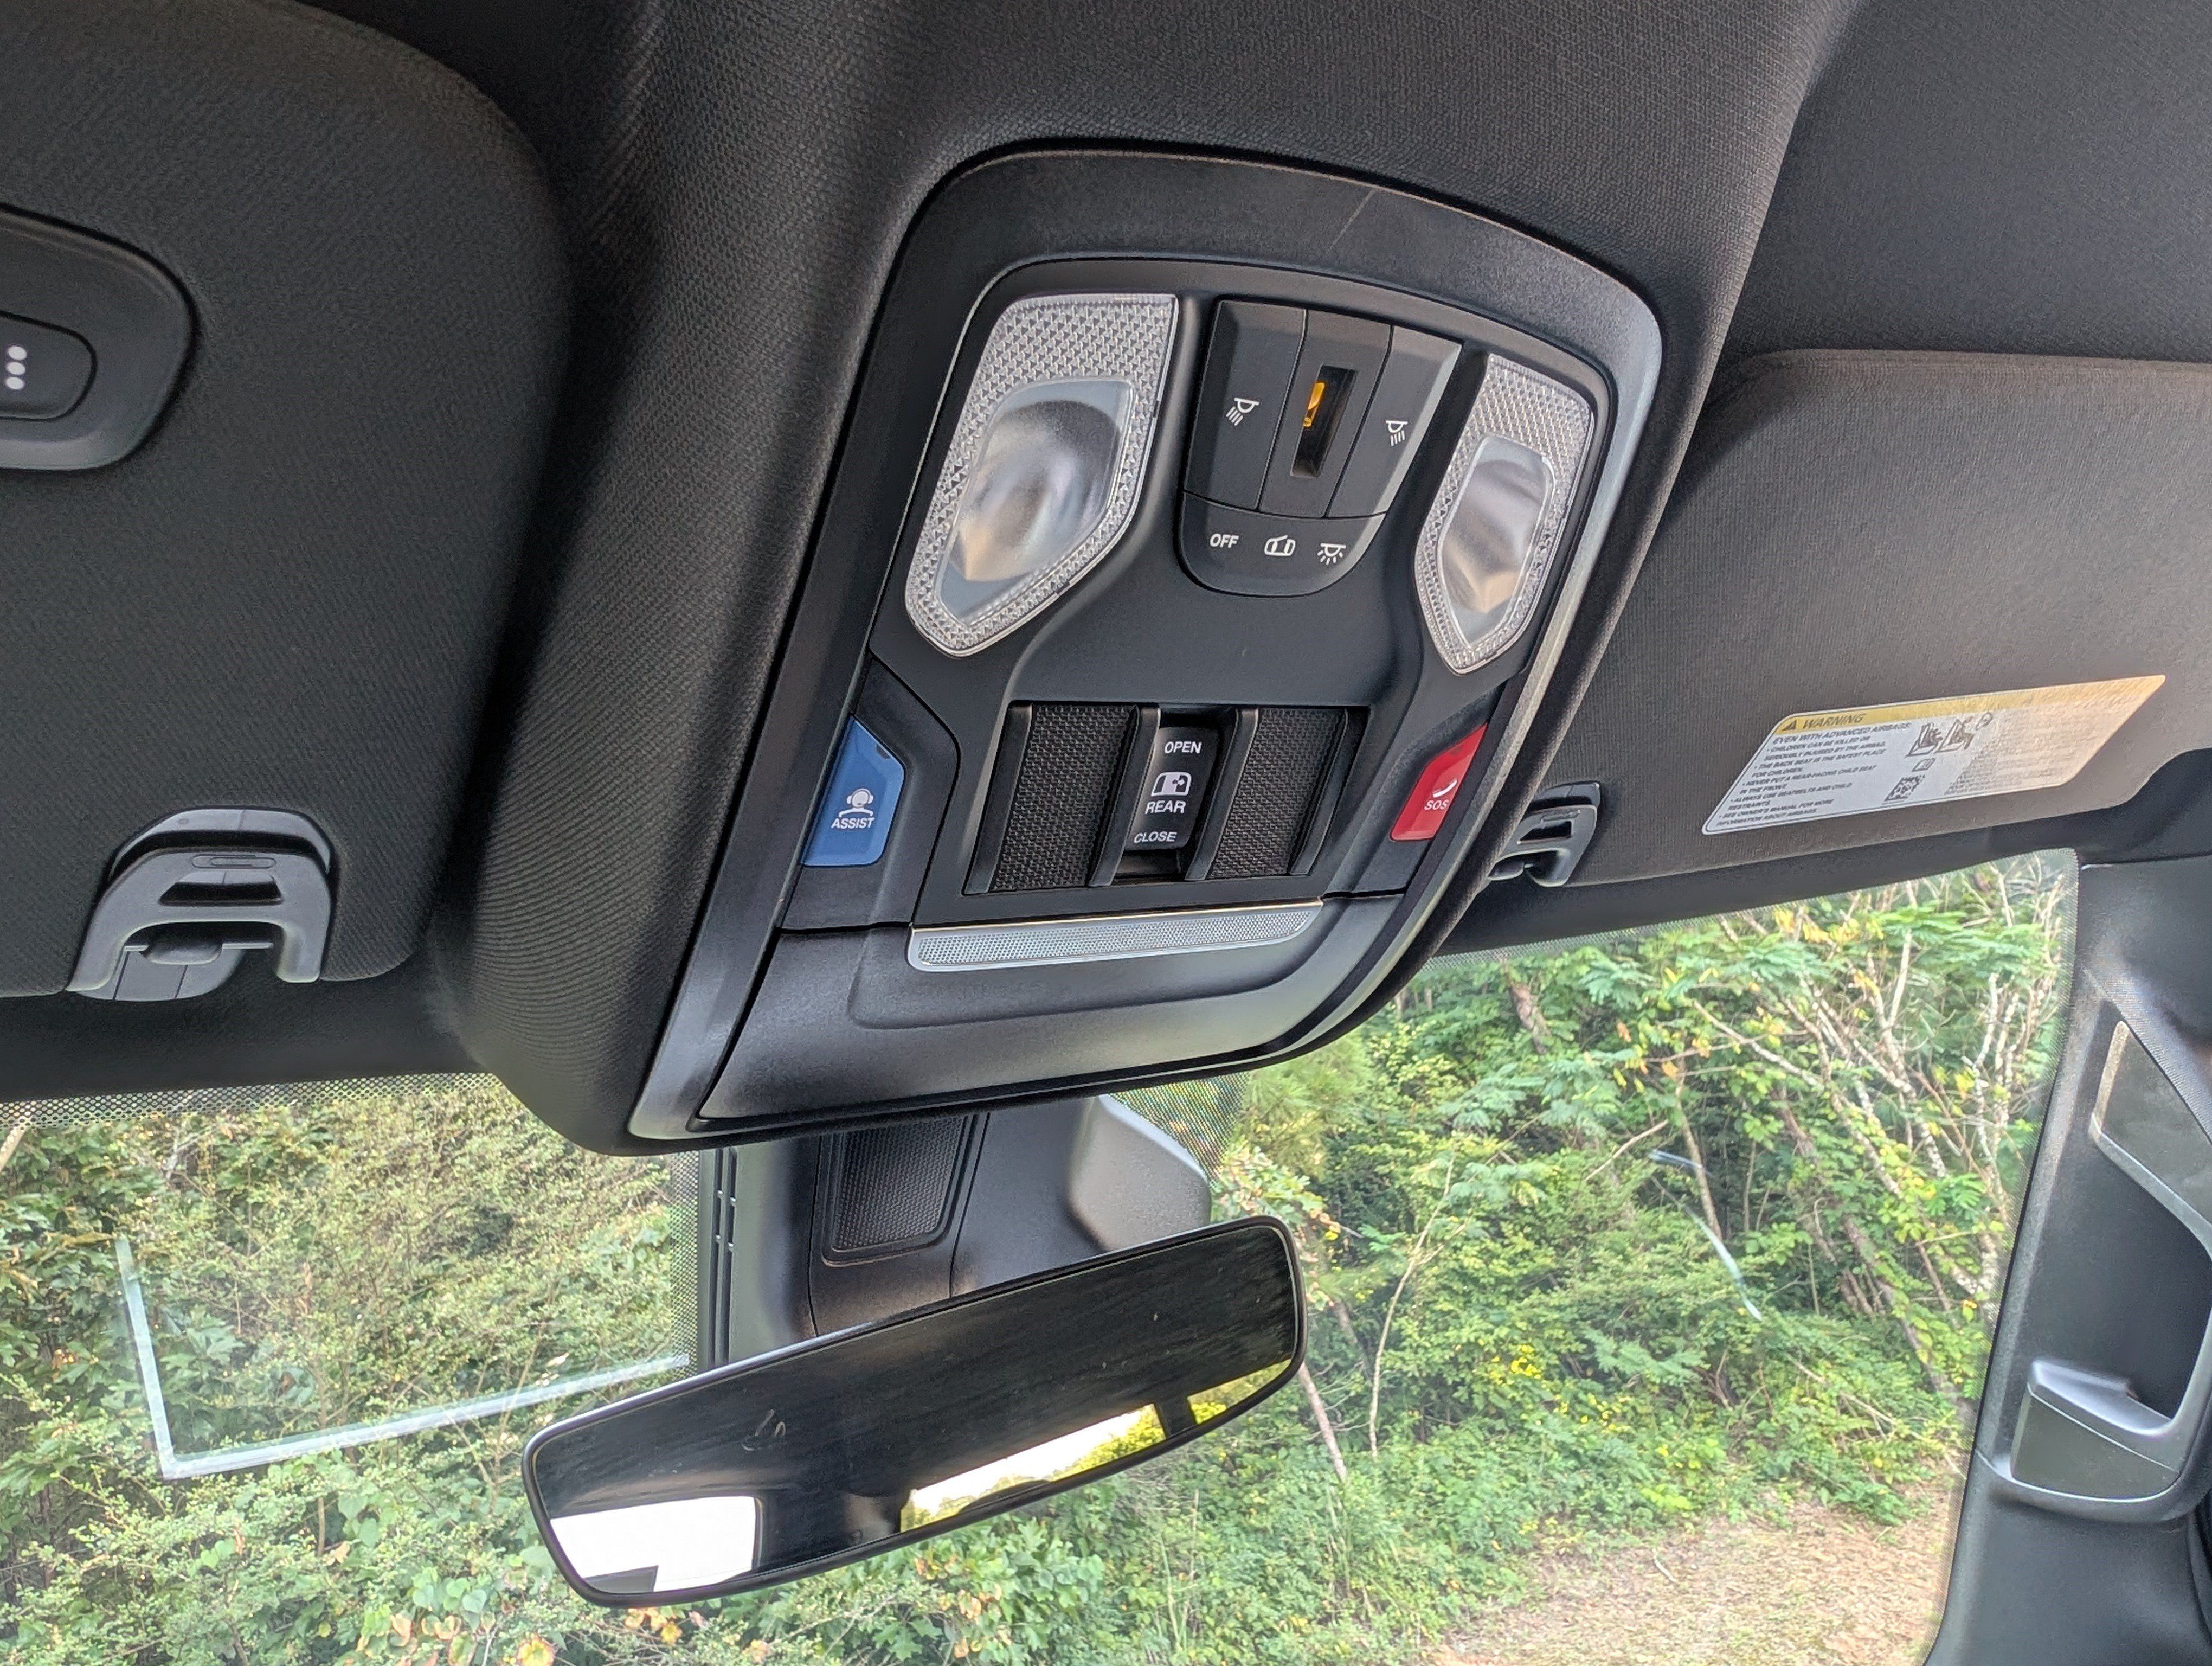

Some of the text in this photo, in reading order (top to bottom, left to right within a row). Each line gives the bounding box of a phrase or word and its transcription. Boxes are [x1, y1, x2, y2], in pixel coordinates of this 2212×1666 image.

[1210, 533, 1239, 548] OFF
[1803, 713, 1866, 729] WARNING
[1165, 741, 1202, 754] OPEN
[1144, 800, 1186, 815] REAR
[1424, 799, 1449, 810] SOS
[831, 817, 876, 829] ASSIST
[1134, 831, 1178, 843] CLOSE
